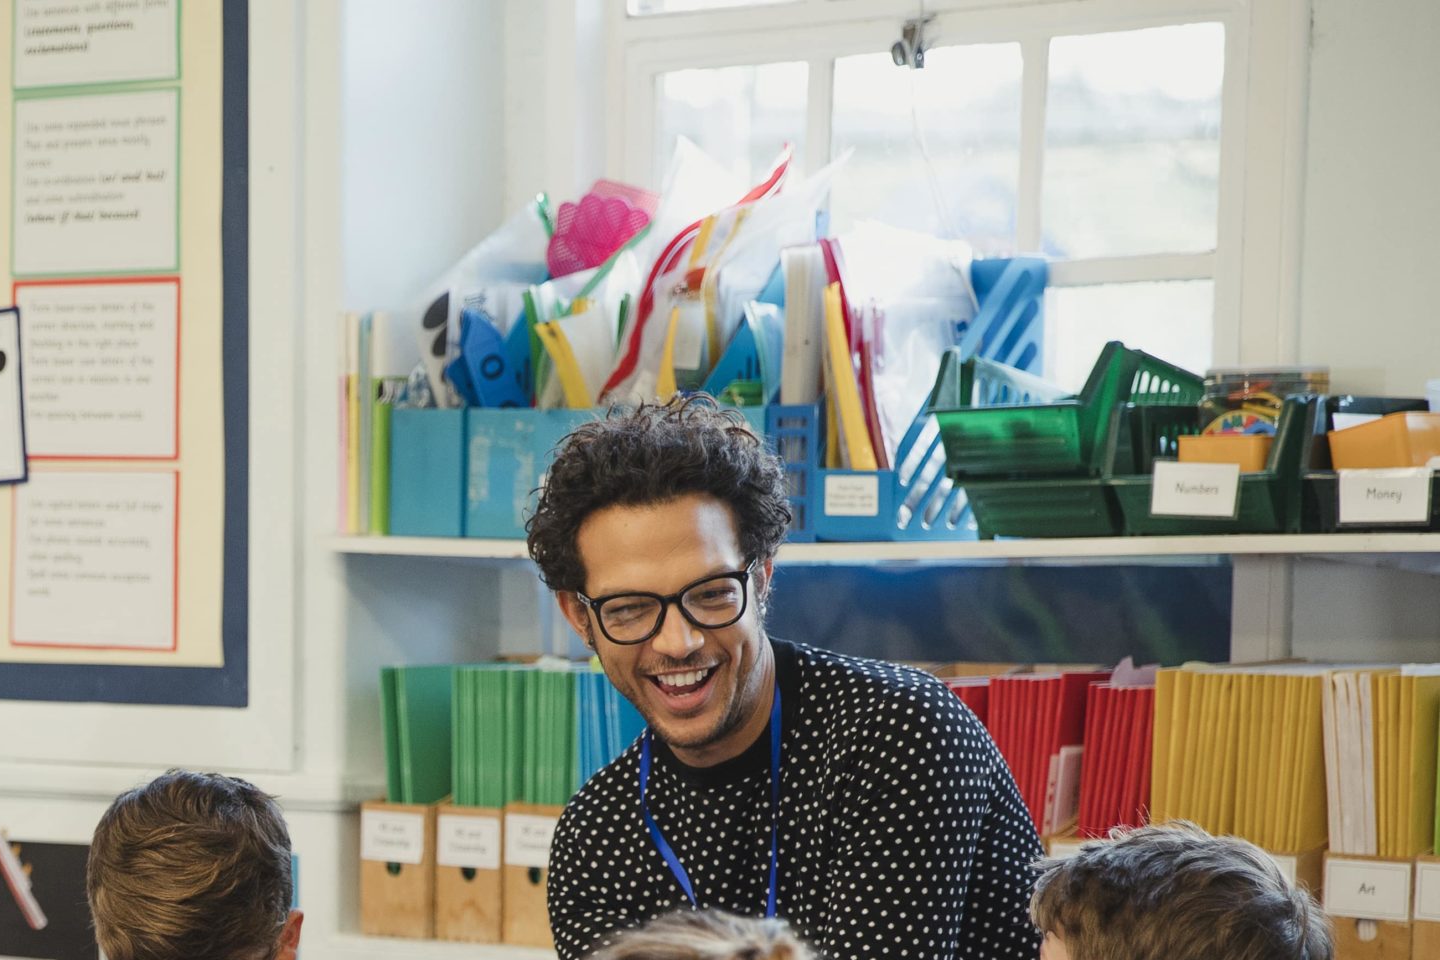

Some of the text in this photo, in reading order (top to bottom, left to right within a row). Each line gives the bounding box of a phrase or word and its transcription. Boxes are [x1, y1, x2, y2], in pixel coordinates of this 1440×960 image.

[1175, 482, 1219, 496] Numbers
[1366, 487, 1402, 502] Money
[1358, 881, 1377, 896] Art
